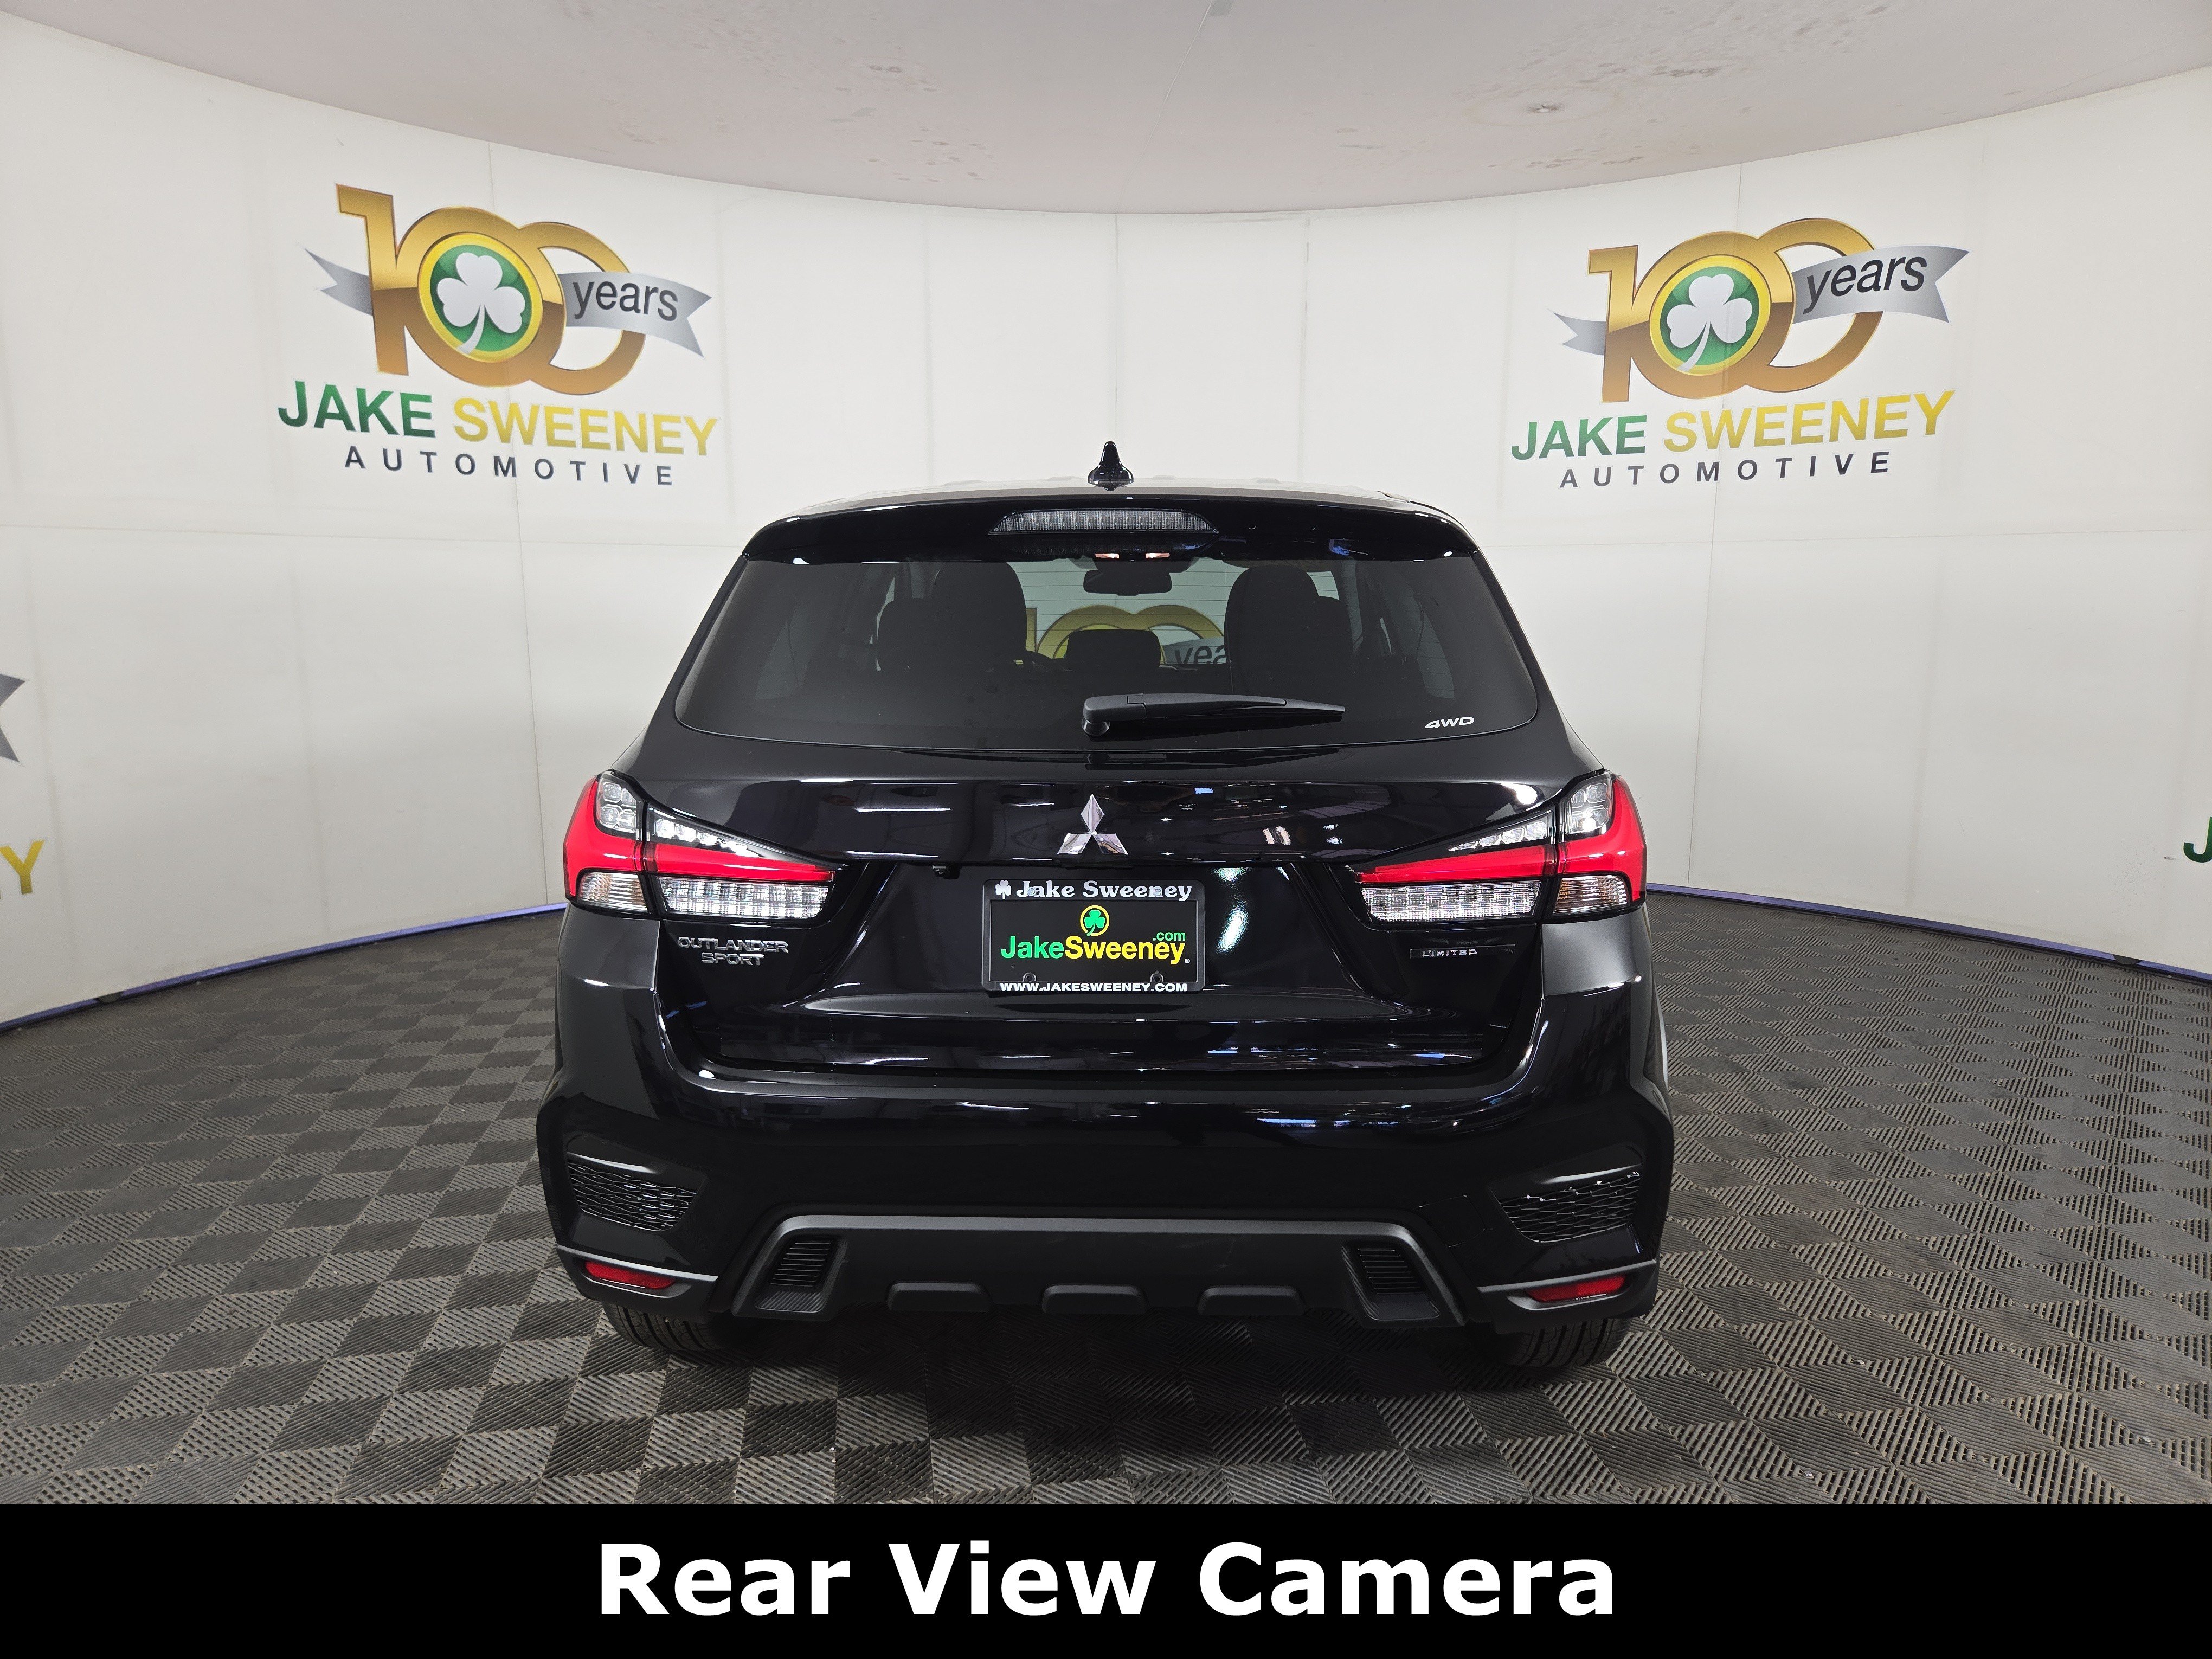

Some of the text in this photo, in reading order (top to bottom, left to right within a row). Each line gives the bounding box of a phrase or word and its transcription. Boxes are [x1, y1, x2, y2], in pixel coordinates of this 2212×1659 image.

[573, 280, 679, 322] years
[1803, 256, 1927, 315] years
[278, 381, 717, 456] JAKE SWEENEY
[1511, 390, 1956, 461] JAKE SWEENEY
[344, 446, 673, 486] AUTOMOTIVE
[1560, 451, 1891, 488] AUTOMOTIVE
[1424, 717, 1475, 729] 4WD
[1016, 880, 1192, 902] Jake Sweeney
[678, 936, 789, 953] OUTLANDER
[701, 952, 765, 966] SPORT
[1001, 931, 1186, 965] JakeSweeney .com
[1422, 949, 1477, 957] LIMITED
[1000, 982, 1188, 993] WWW.JAKESWEENEY.COM
